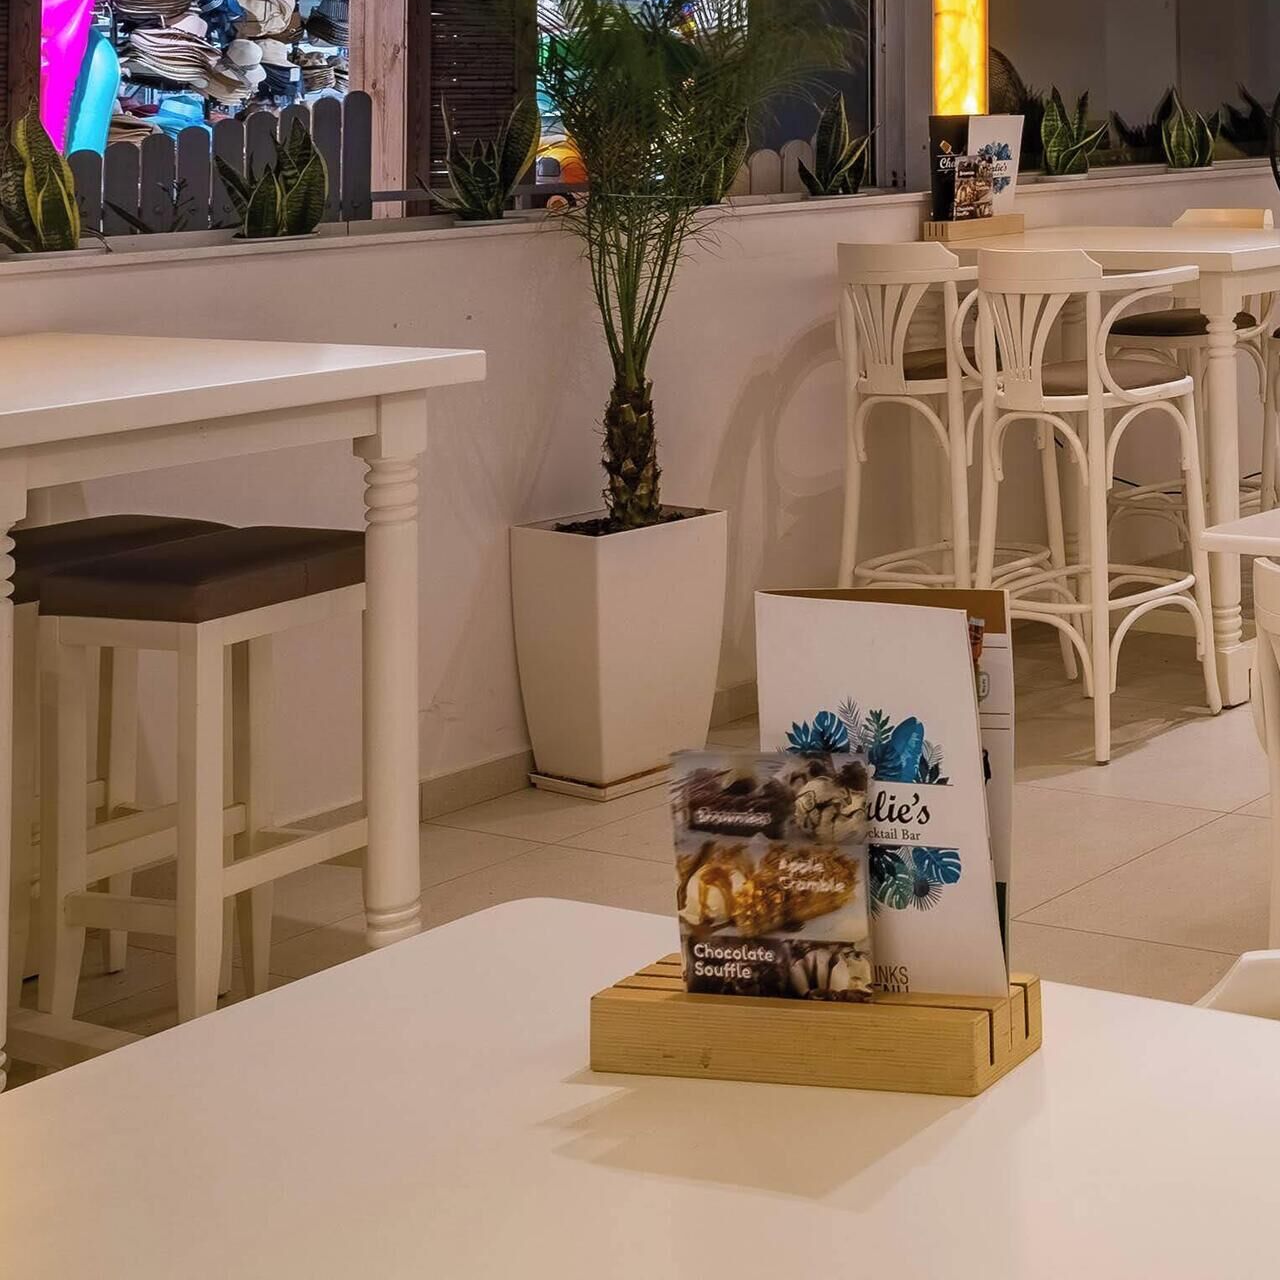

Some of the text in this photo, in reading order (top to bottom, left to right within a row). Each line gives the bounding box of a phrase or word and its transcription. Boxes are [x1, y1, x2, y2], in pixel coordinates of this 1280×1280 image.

[867, 790, 930, 825] lie's
[866, 827, 921, 841] cktail Bar
[693, 943, 775, 962] Chocolate
[694, 960, 752, 980] Souffle
[874, 965, 909, 985] INKS
